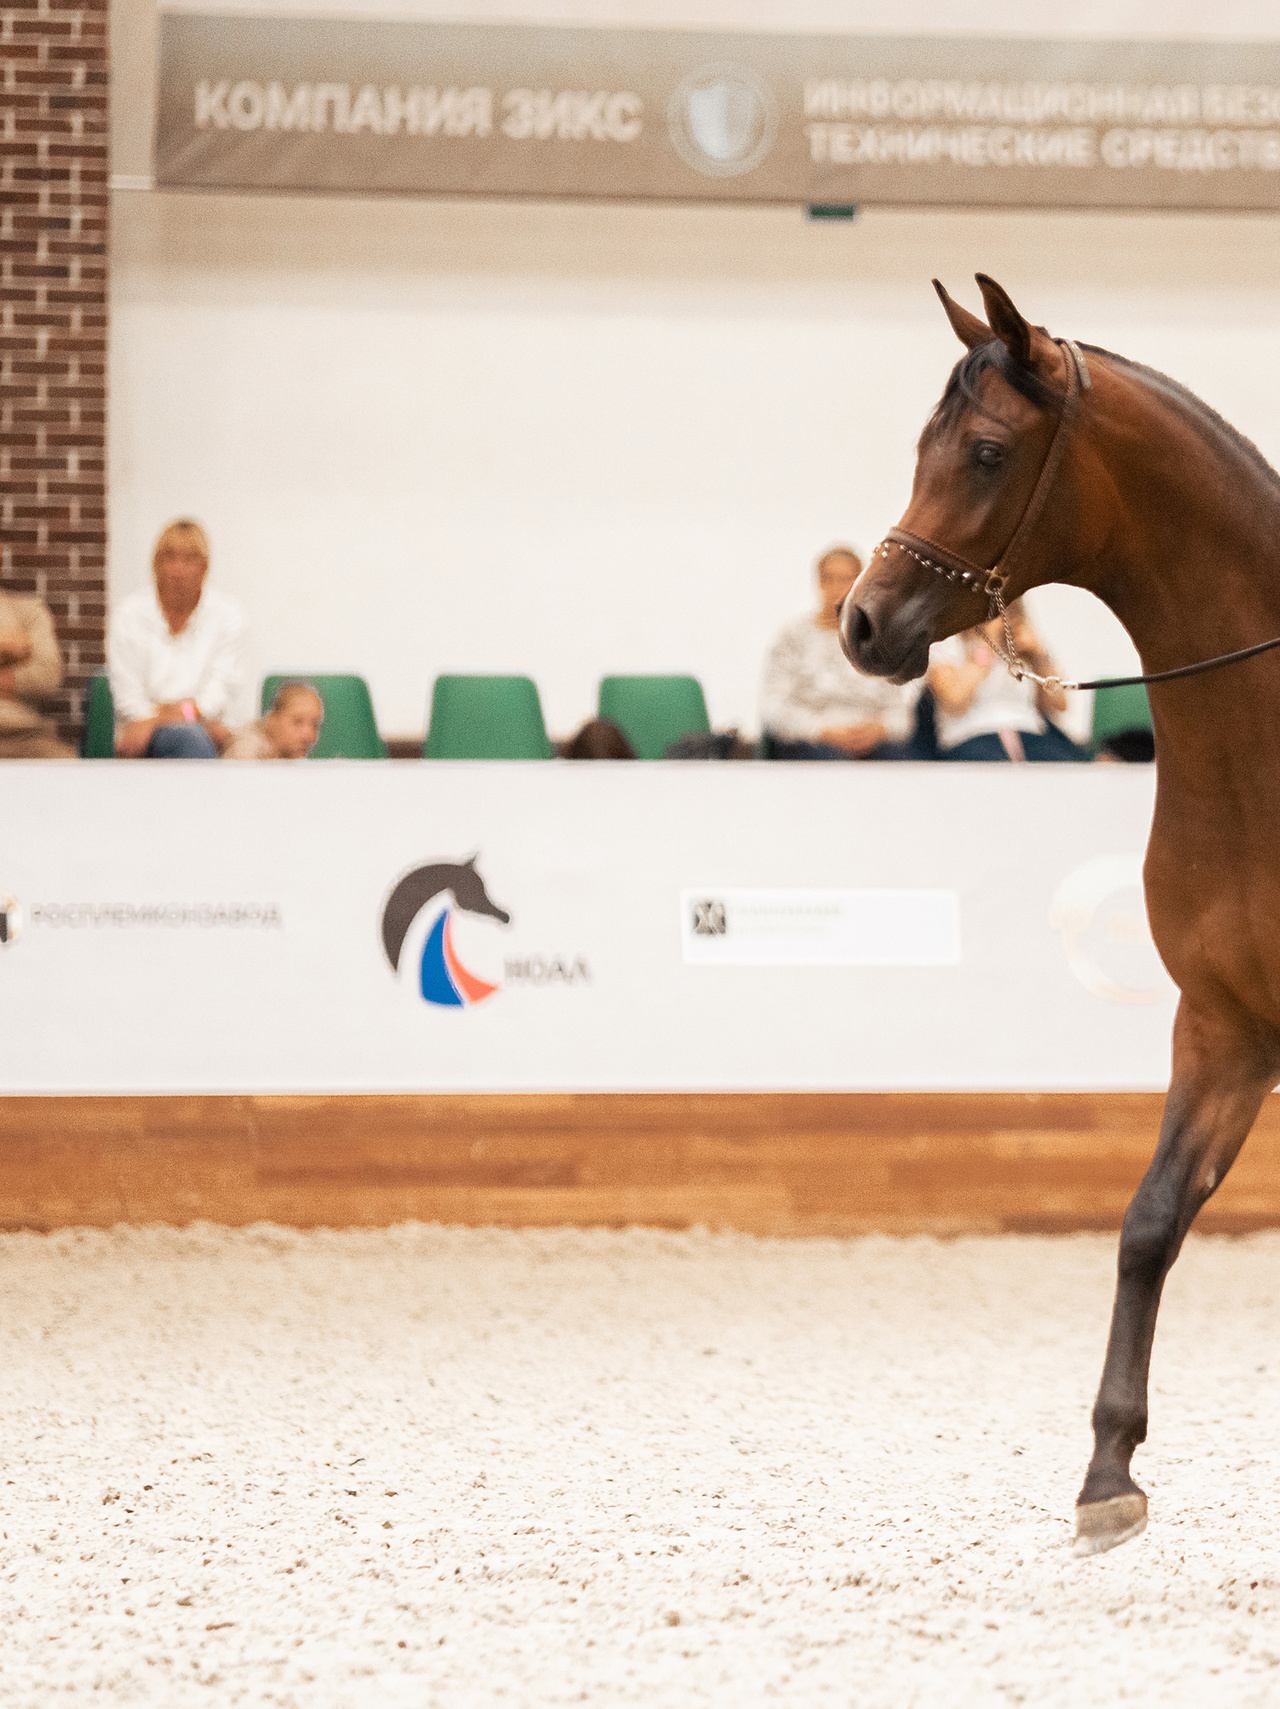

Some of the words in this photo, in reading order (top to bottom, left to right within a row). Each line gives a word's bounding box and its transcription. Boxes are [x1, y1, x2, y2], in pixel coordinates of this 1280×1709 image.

[195, 79, 494, 137] КОМПАНИЯ
[501, 87, 643, 142] ЗИКС
[803, 78, 1197, 122] ИНФОРМАЦИОННАЯ
[808, 123, 1097, 168] ТЕХНИЧЕСКИЕ
